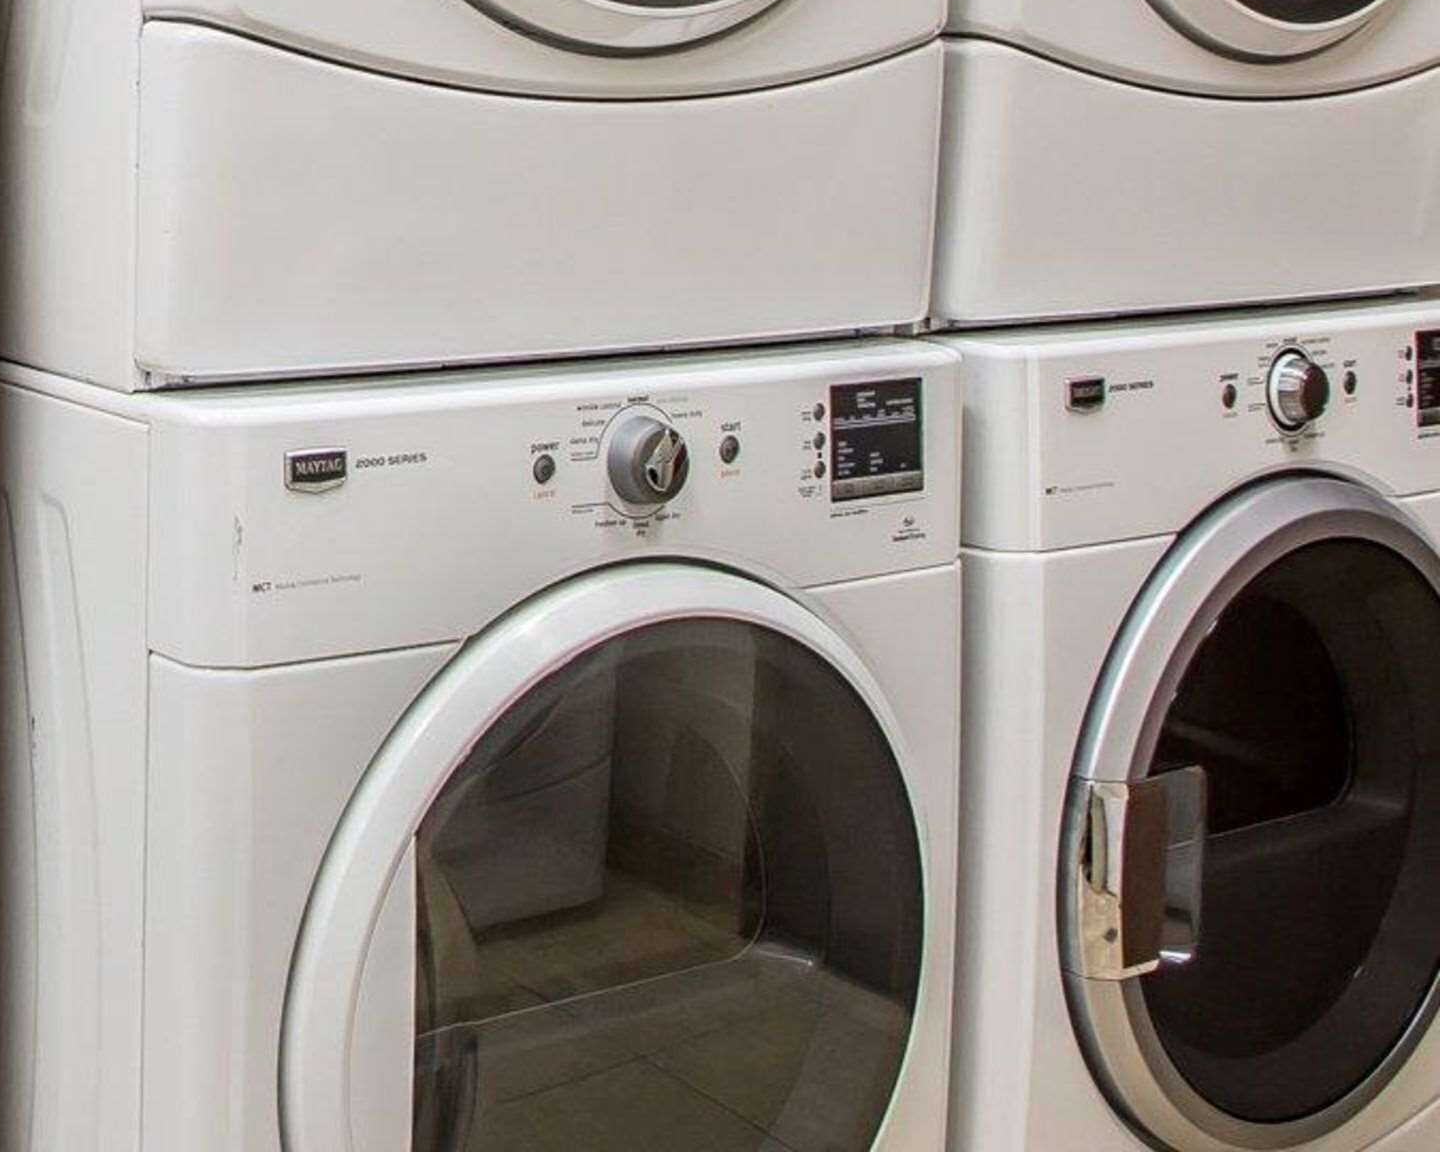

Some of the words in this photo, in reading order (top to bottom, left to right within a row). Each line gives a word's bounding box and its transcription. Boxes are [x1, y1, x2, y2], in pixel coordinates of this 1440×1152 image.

[720, 421, 742, 432] start
[531, 441, 560, 454] power
[294, 457, 344, 476] MAYTAG
[355, 456, 385, 469] 2000
[387, 452, 428, 466] SERIES
